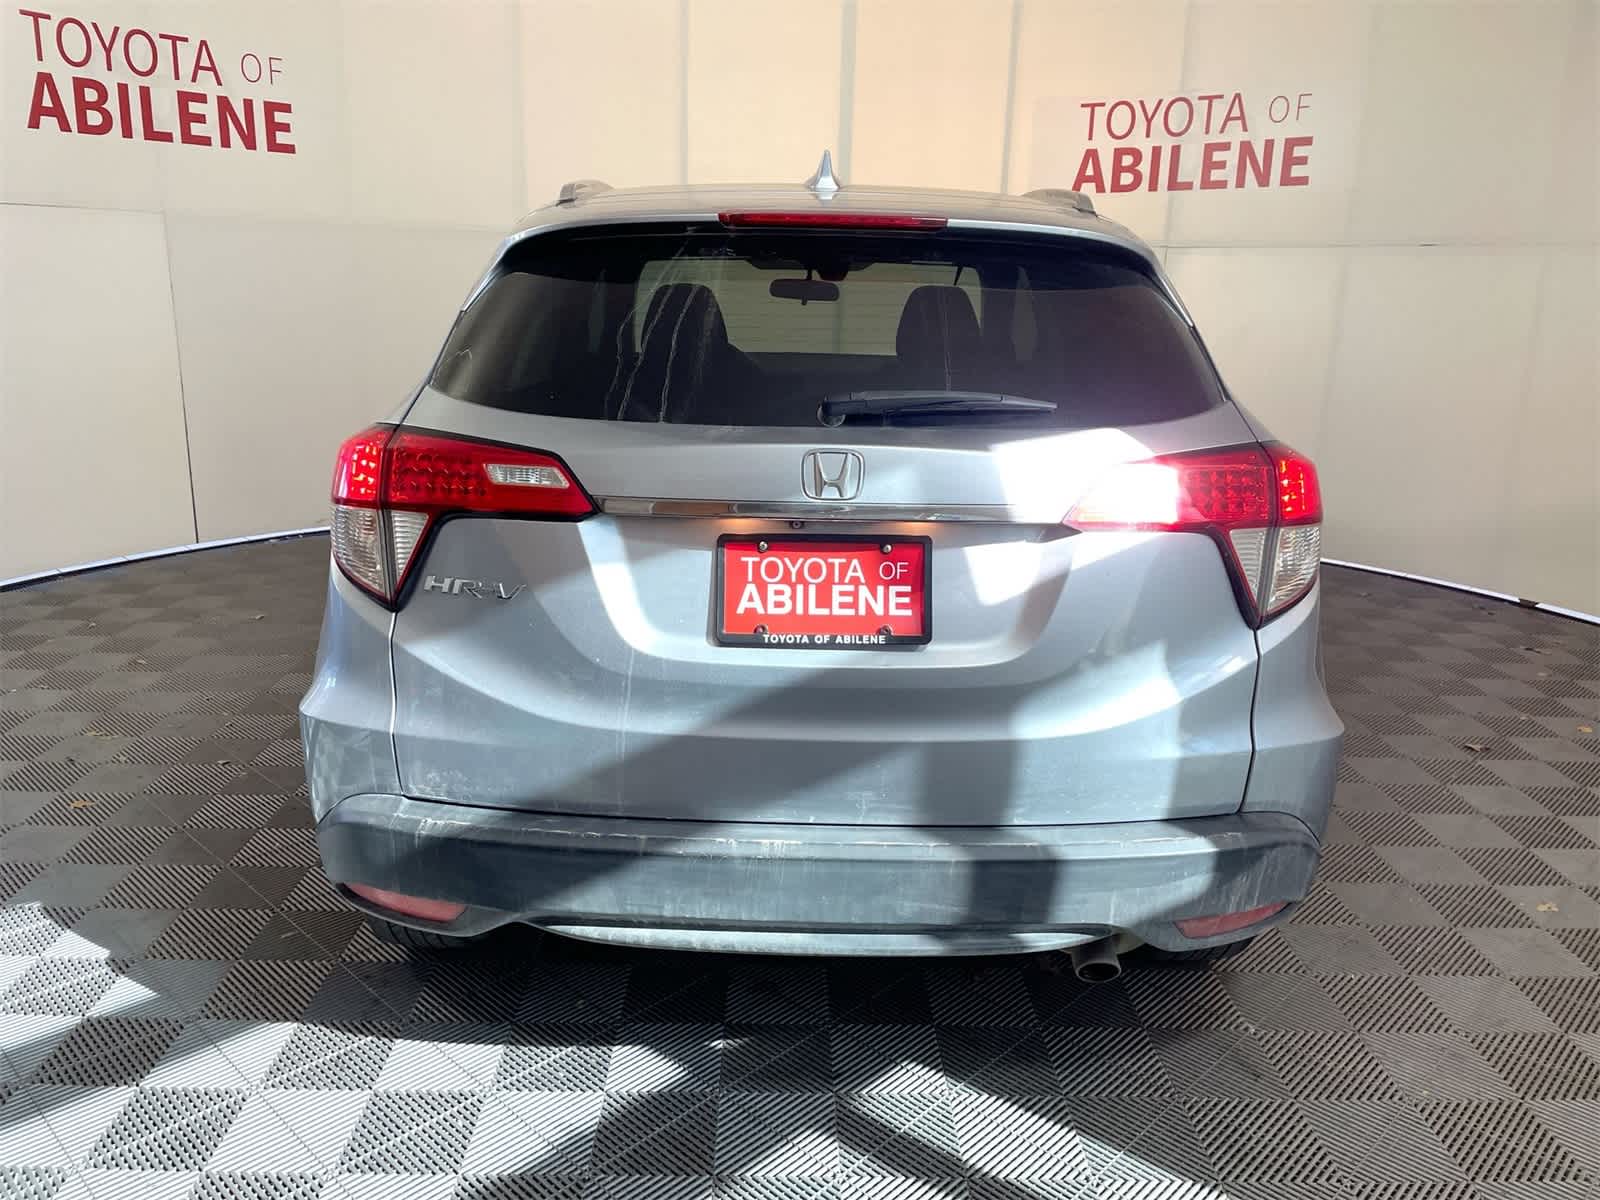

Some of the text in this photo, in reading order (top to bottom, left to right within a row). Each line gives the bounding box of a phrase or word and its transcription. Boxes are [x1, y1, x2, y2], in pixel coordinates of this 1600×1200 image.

[19, 9, 283, 86] TOYOTA OF
[27, 71, 297, 154] ABILENE
[1080, 93, 1313, 141] TOYOTA OF
[1071, 136, 1314, 194] ABILENE
[741, 557, 910, 584] TOYOTA OF
[736, 583, 913, 616] ABILENE
[762, 634, 886, 645] TOYOTA OF ABILENE
